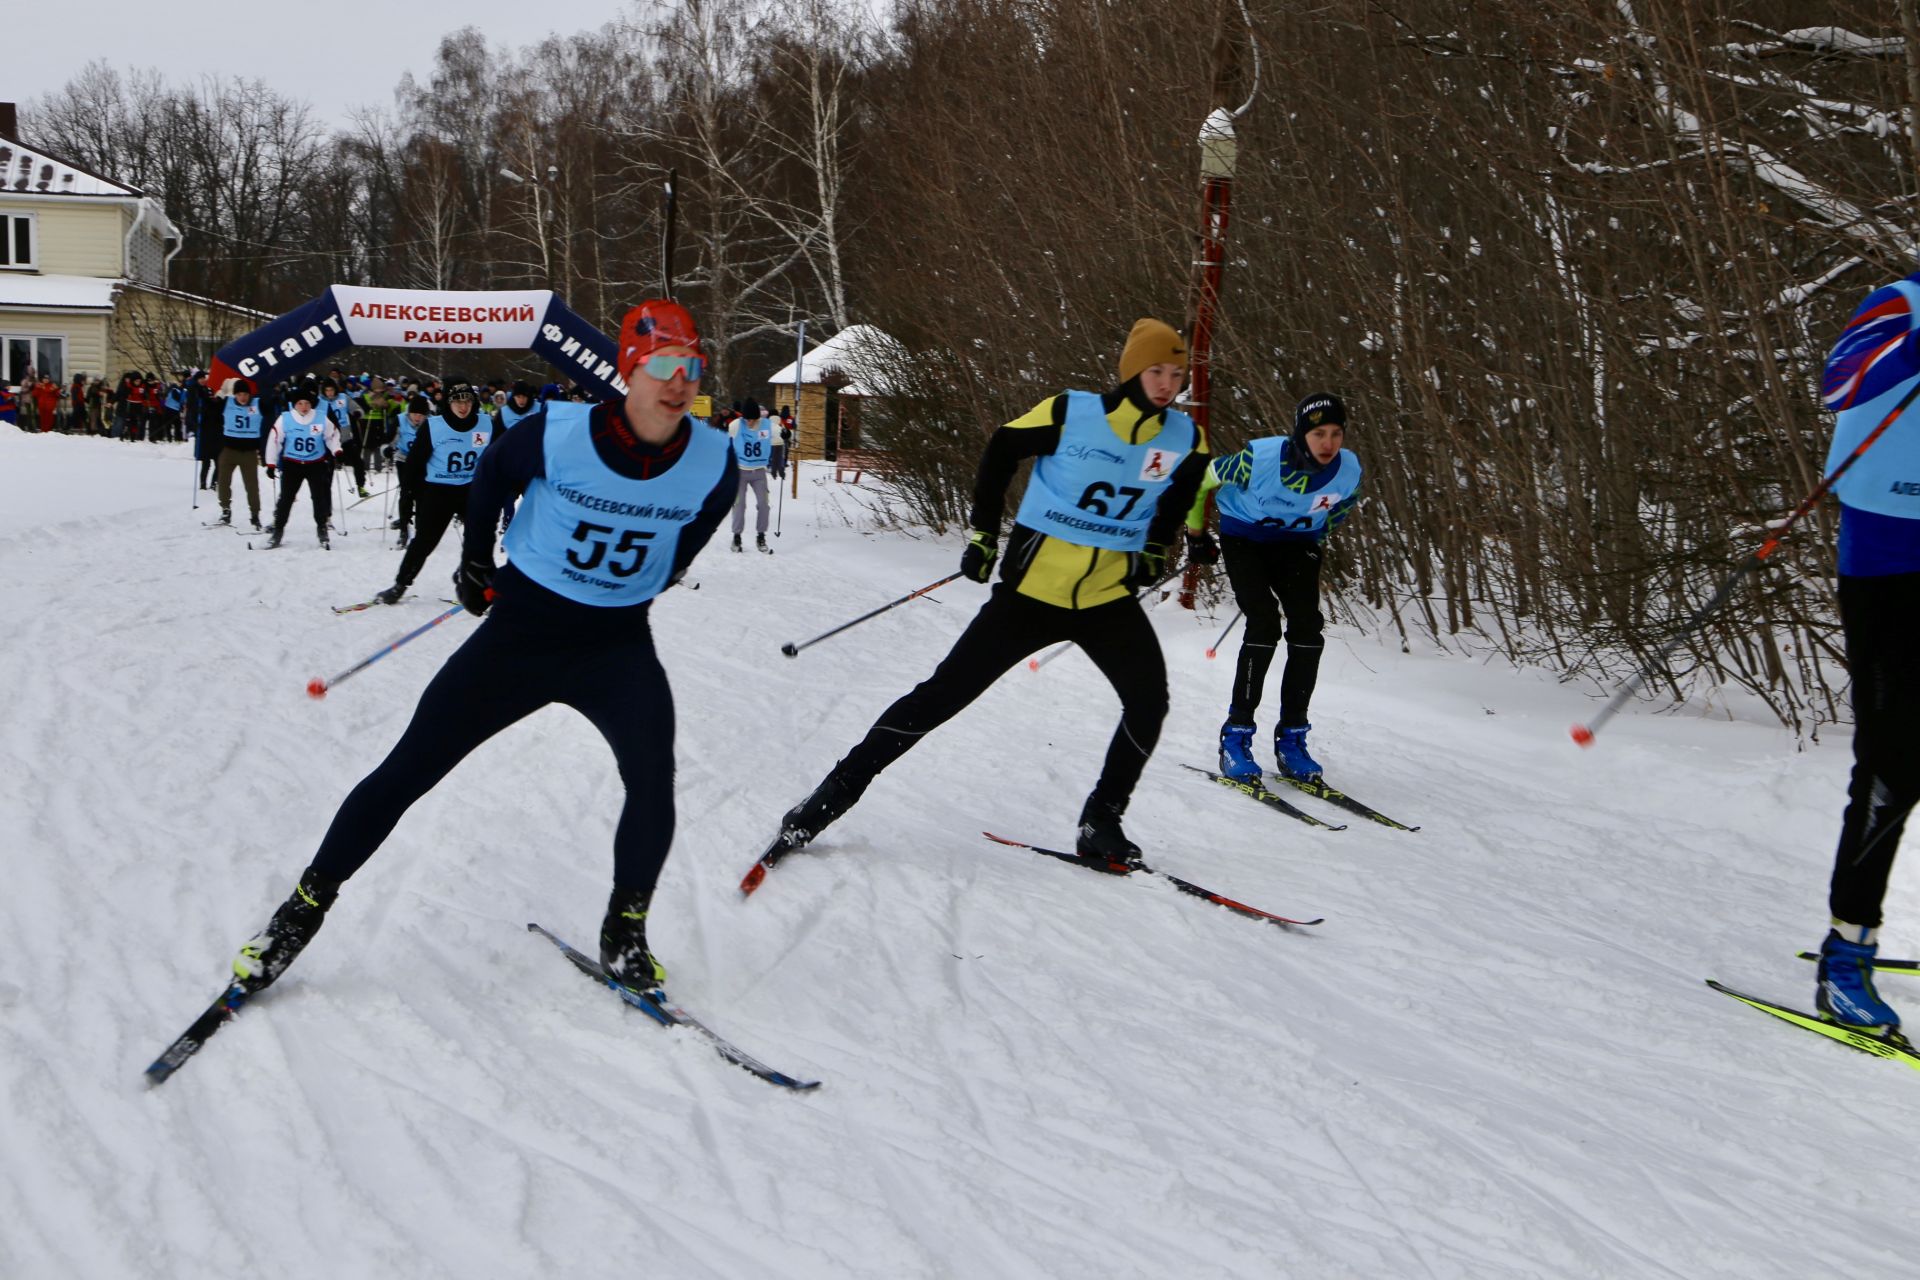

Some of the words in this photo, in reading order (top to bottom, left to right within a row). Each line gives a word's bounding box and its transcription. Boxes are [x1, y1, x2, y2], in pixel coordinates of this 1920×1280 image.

[350, 302, 535, 323] АЛЕКСЕЕВСКИЙ
[404, 328, 483, 345] РАЙОН
[234, 415, 251, 429] 51
[294, 437, 316, 453] 66
[447, 451, 477, 473] 69
[1076, 481, 1146, 520] 67
[566, 520, 657, 578] 55
